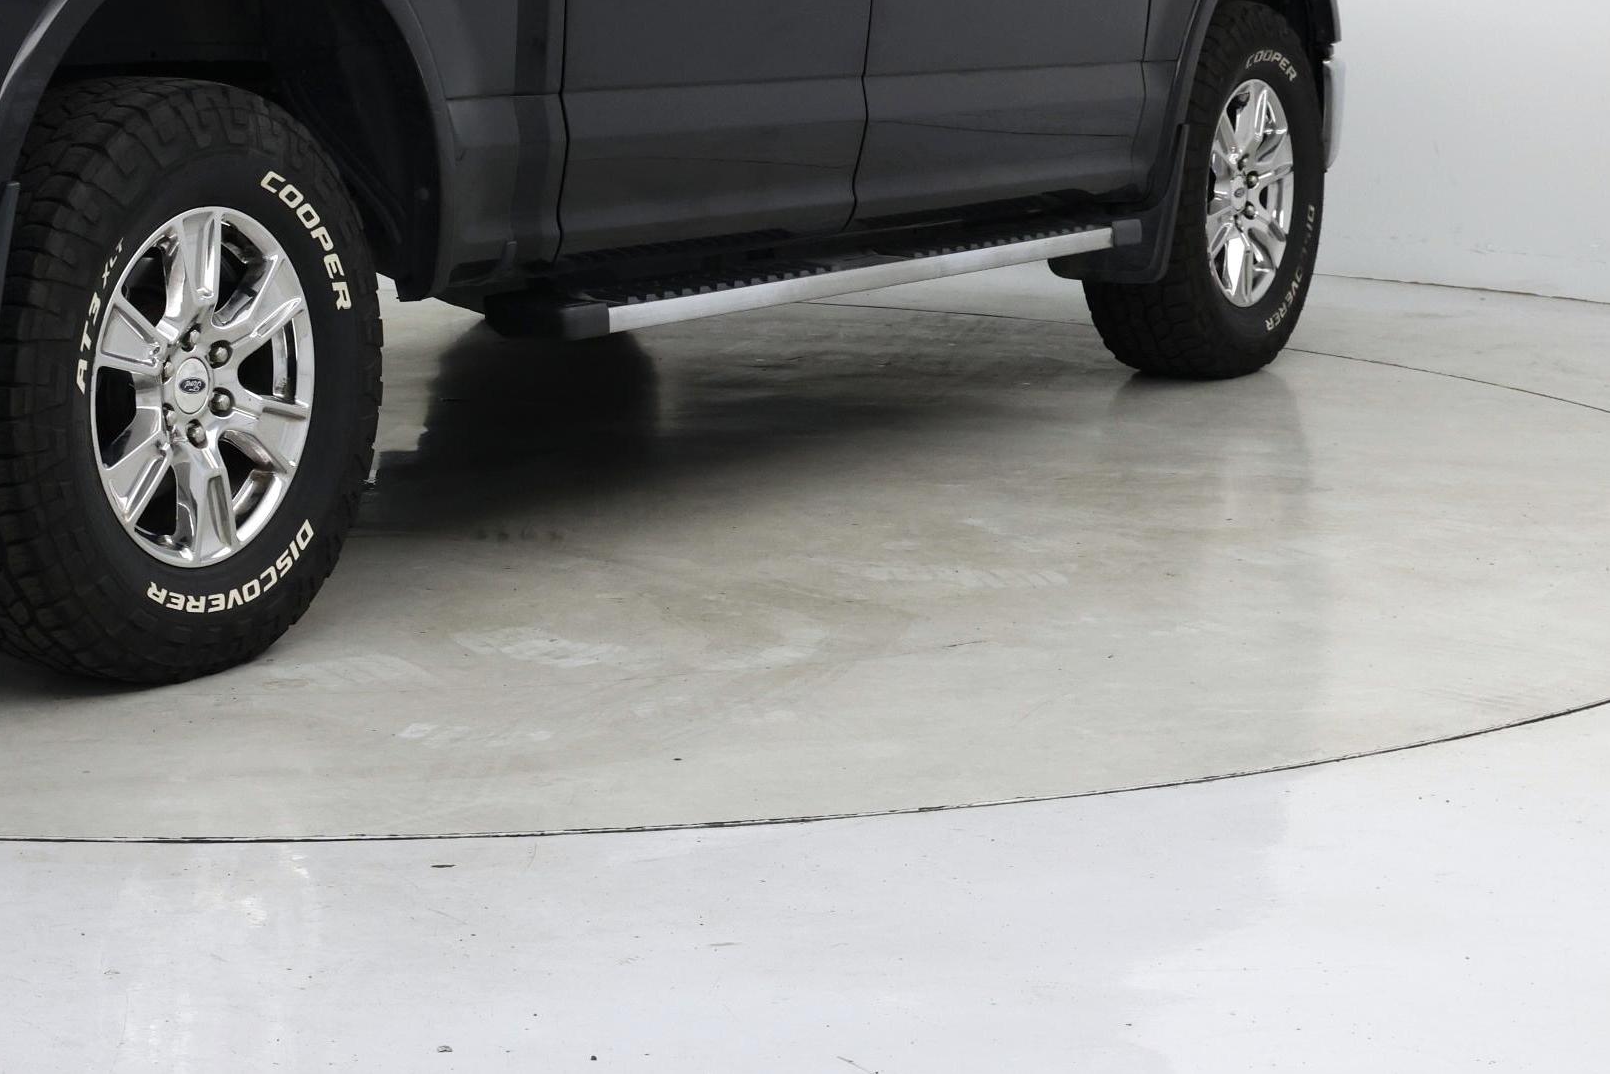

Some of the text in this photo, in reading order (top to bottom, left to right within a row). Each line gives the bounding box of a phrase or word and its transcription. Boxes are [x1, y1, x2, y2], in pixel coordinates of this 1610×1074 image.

[1245, 49, 1297, 81] COOPER
[260, 170, 352, 311] COOPER
[1265, 204, 1316, 331] DIOVERER
[76, 291, 102, 395] AT3
[146, 518, 315, 614] DISCOVERER
